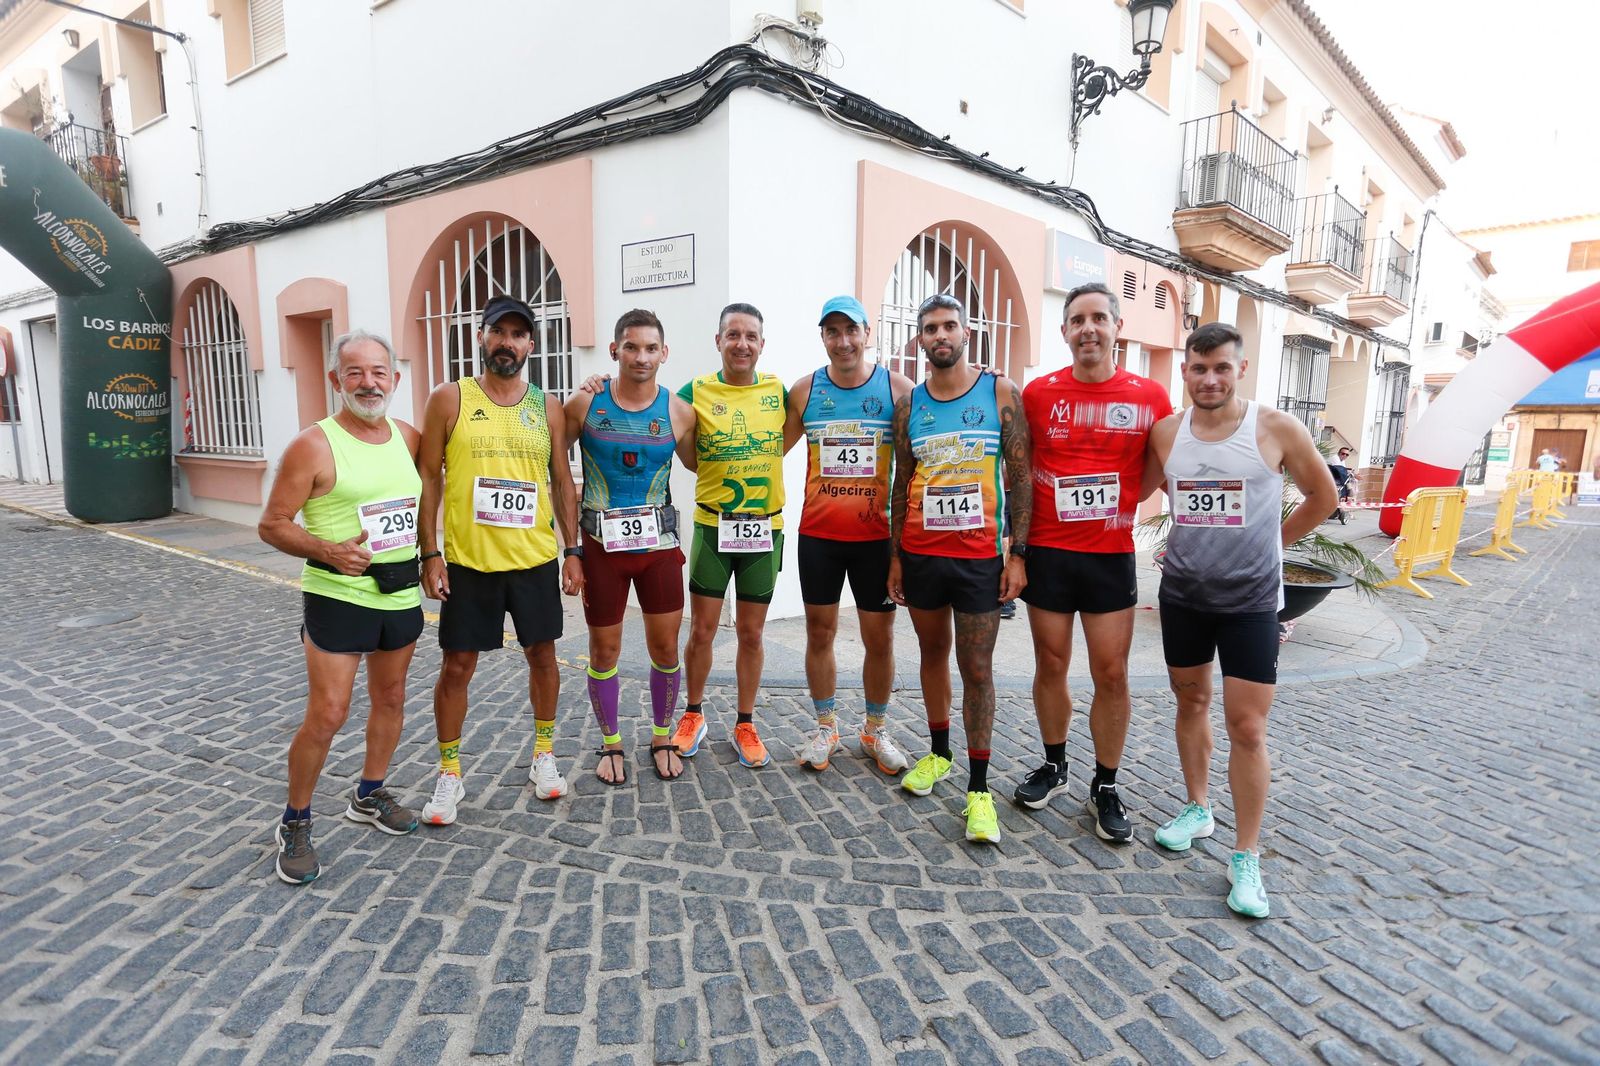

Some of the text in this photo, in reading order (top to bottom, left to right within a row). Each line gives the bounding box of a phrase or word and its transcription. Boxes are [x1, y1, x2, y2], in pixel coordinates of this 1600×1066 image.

[33, 211, 112, 275] ALCORNOCALES
[641, 243, 674, 257] ESTUDIO
[651, 259, 662, 269] DE
[630, 270, 689, 286] ARQUITECTURA
[83, 316, 171, 334] LOS BARRIOS
[108, 334, 161, 351] CÁDIZ
[87, 391, 167, 410] ALCORNOCALES
[837, 449, 859, 464] 43
[818, 484, 877, 497] Algeciras
[1071, 488, 1105, 506] 191
[490, 492, 526, 511] 180
[936, 497, 970, 515] 114
[1188, 493, 1226, 511] 391
[379, 511, 414, 535] 299
[621, 519, 642, 536] 39
[732, 523, 762, 538] 152
